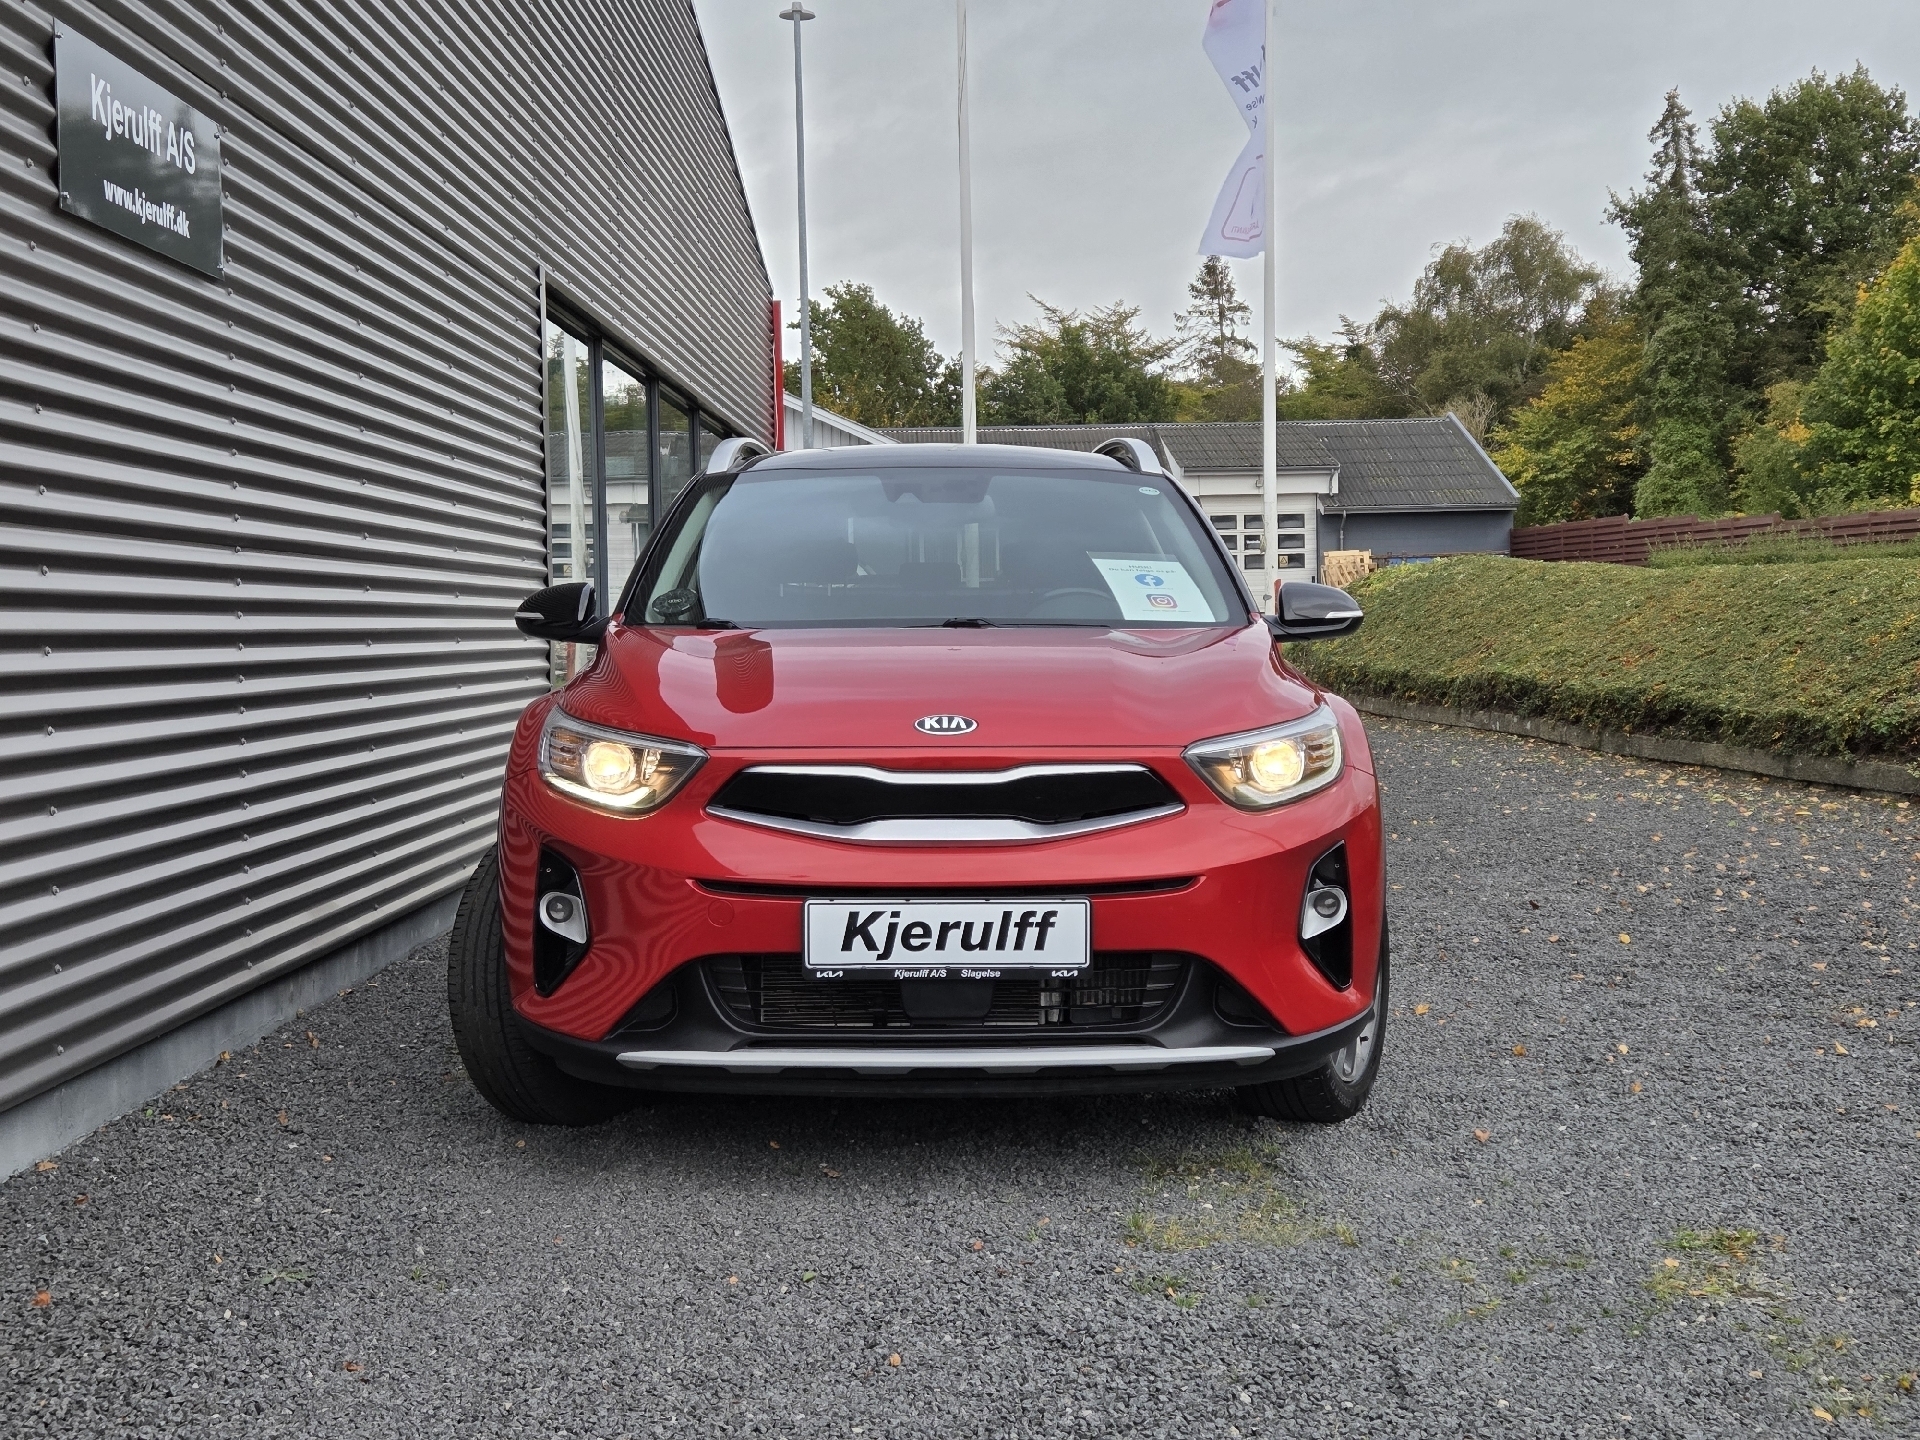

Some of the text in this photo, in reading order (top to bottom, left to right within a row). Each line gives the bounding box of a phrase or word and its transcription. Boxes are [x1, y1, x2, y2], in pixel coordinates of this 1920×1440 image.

[90, 72, 196, 175] Kjerulff A/S
[103, 179, 191, 239] www.kjerulff.dk
[924, 716, 967, 729] KIA
[840, 910, 1058, 961] Kjerulff
[816, 970, 844, 978] KIA
[894, 969, 1001, 980] Kjerulff A/S Slagelse
[1051, 970, 1079, 978] KIA
